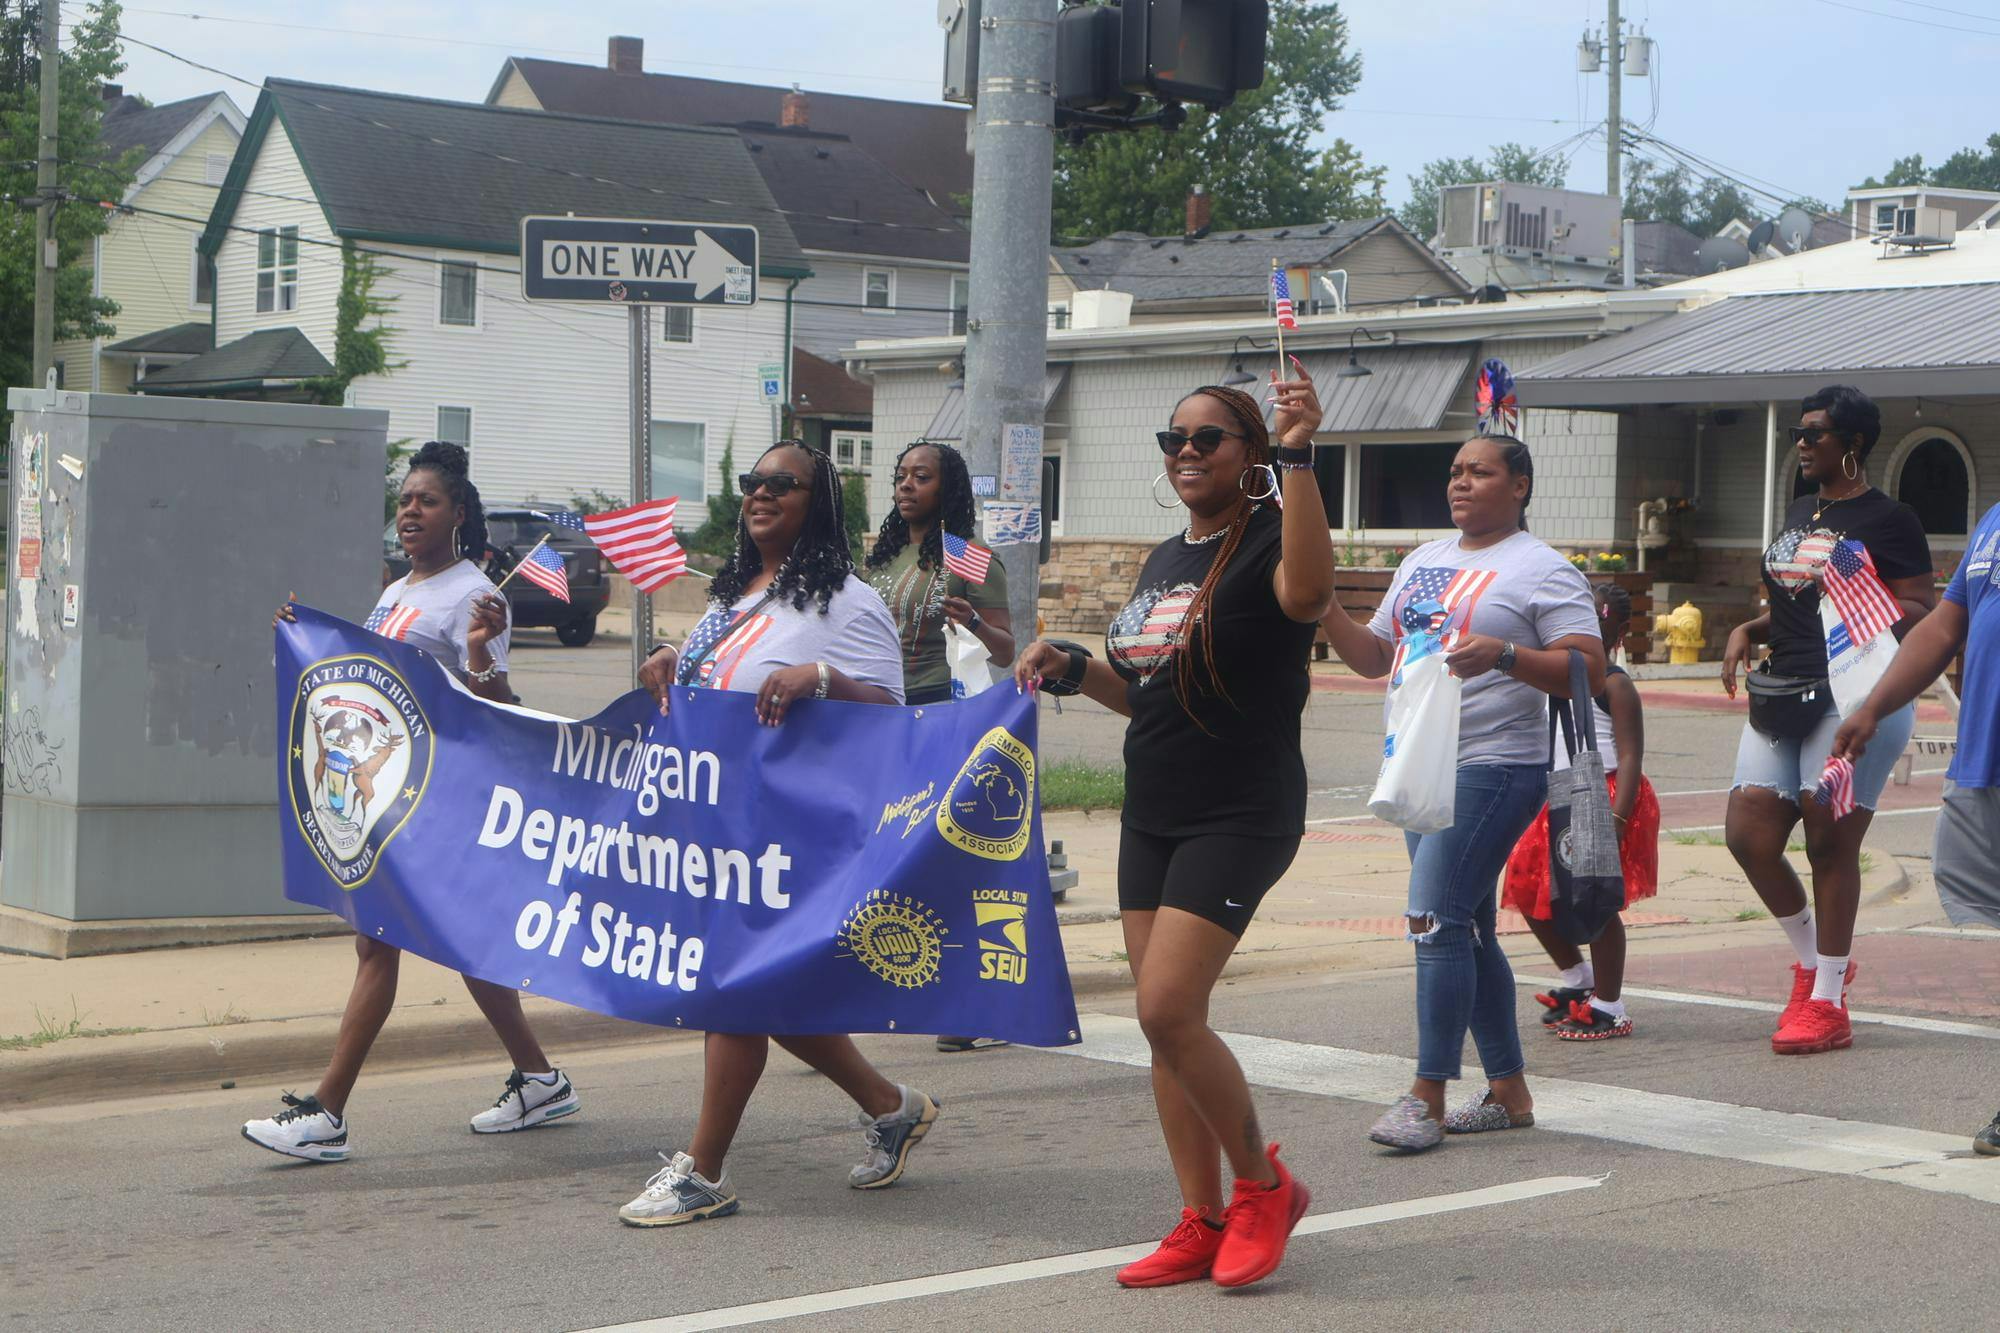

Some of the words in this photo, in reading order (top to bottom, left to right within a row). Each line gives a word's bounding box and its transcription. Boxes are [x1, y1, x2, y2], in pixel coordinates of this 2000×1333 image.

[551, 244, 620, 276] ONE
[632, 247, 696, 279] WAY
[301, 666, 344, 700] STATE
[348, 664, 366, 679] OF
[366, 665, 425, 738] MICHIGAN
[552, 722, 720, 816] Michigan
[477, 784, 792, 909] Department
[958, 829, 1028, 855] ASSOCIATION
[350, 843, 374, 878] STATE
[972, 889, 1010, 901] LOCAL
[837, 901, 860, 947] STATE
[866, 888, 949, 935] EMPLOYEES
[877, 926, 901, 935] LOCAL
[514, 891, 582, 957] of
[581, 901, 704, 991] State
[873, 932, 919, 956] UAW
[892, 955, 911, 963] 6000
[979, 951, 1028, 985] SEIU
